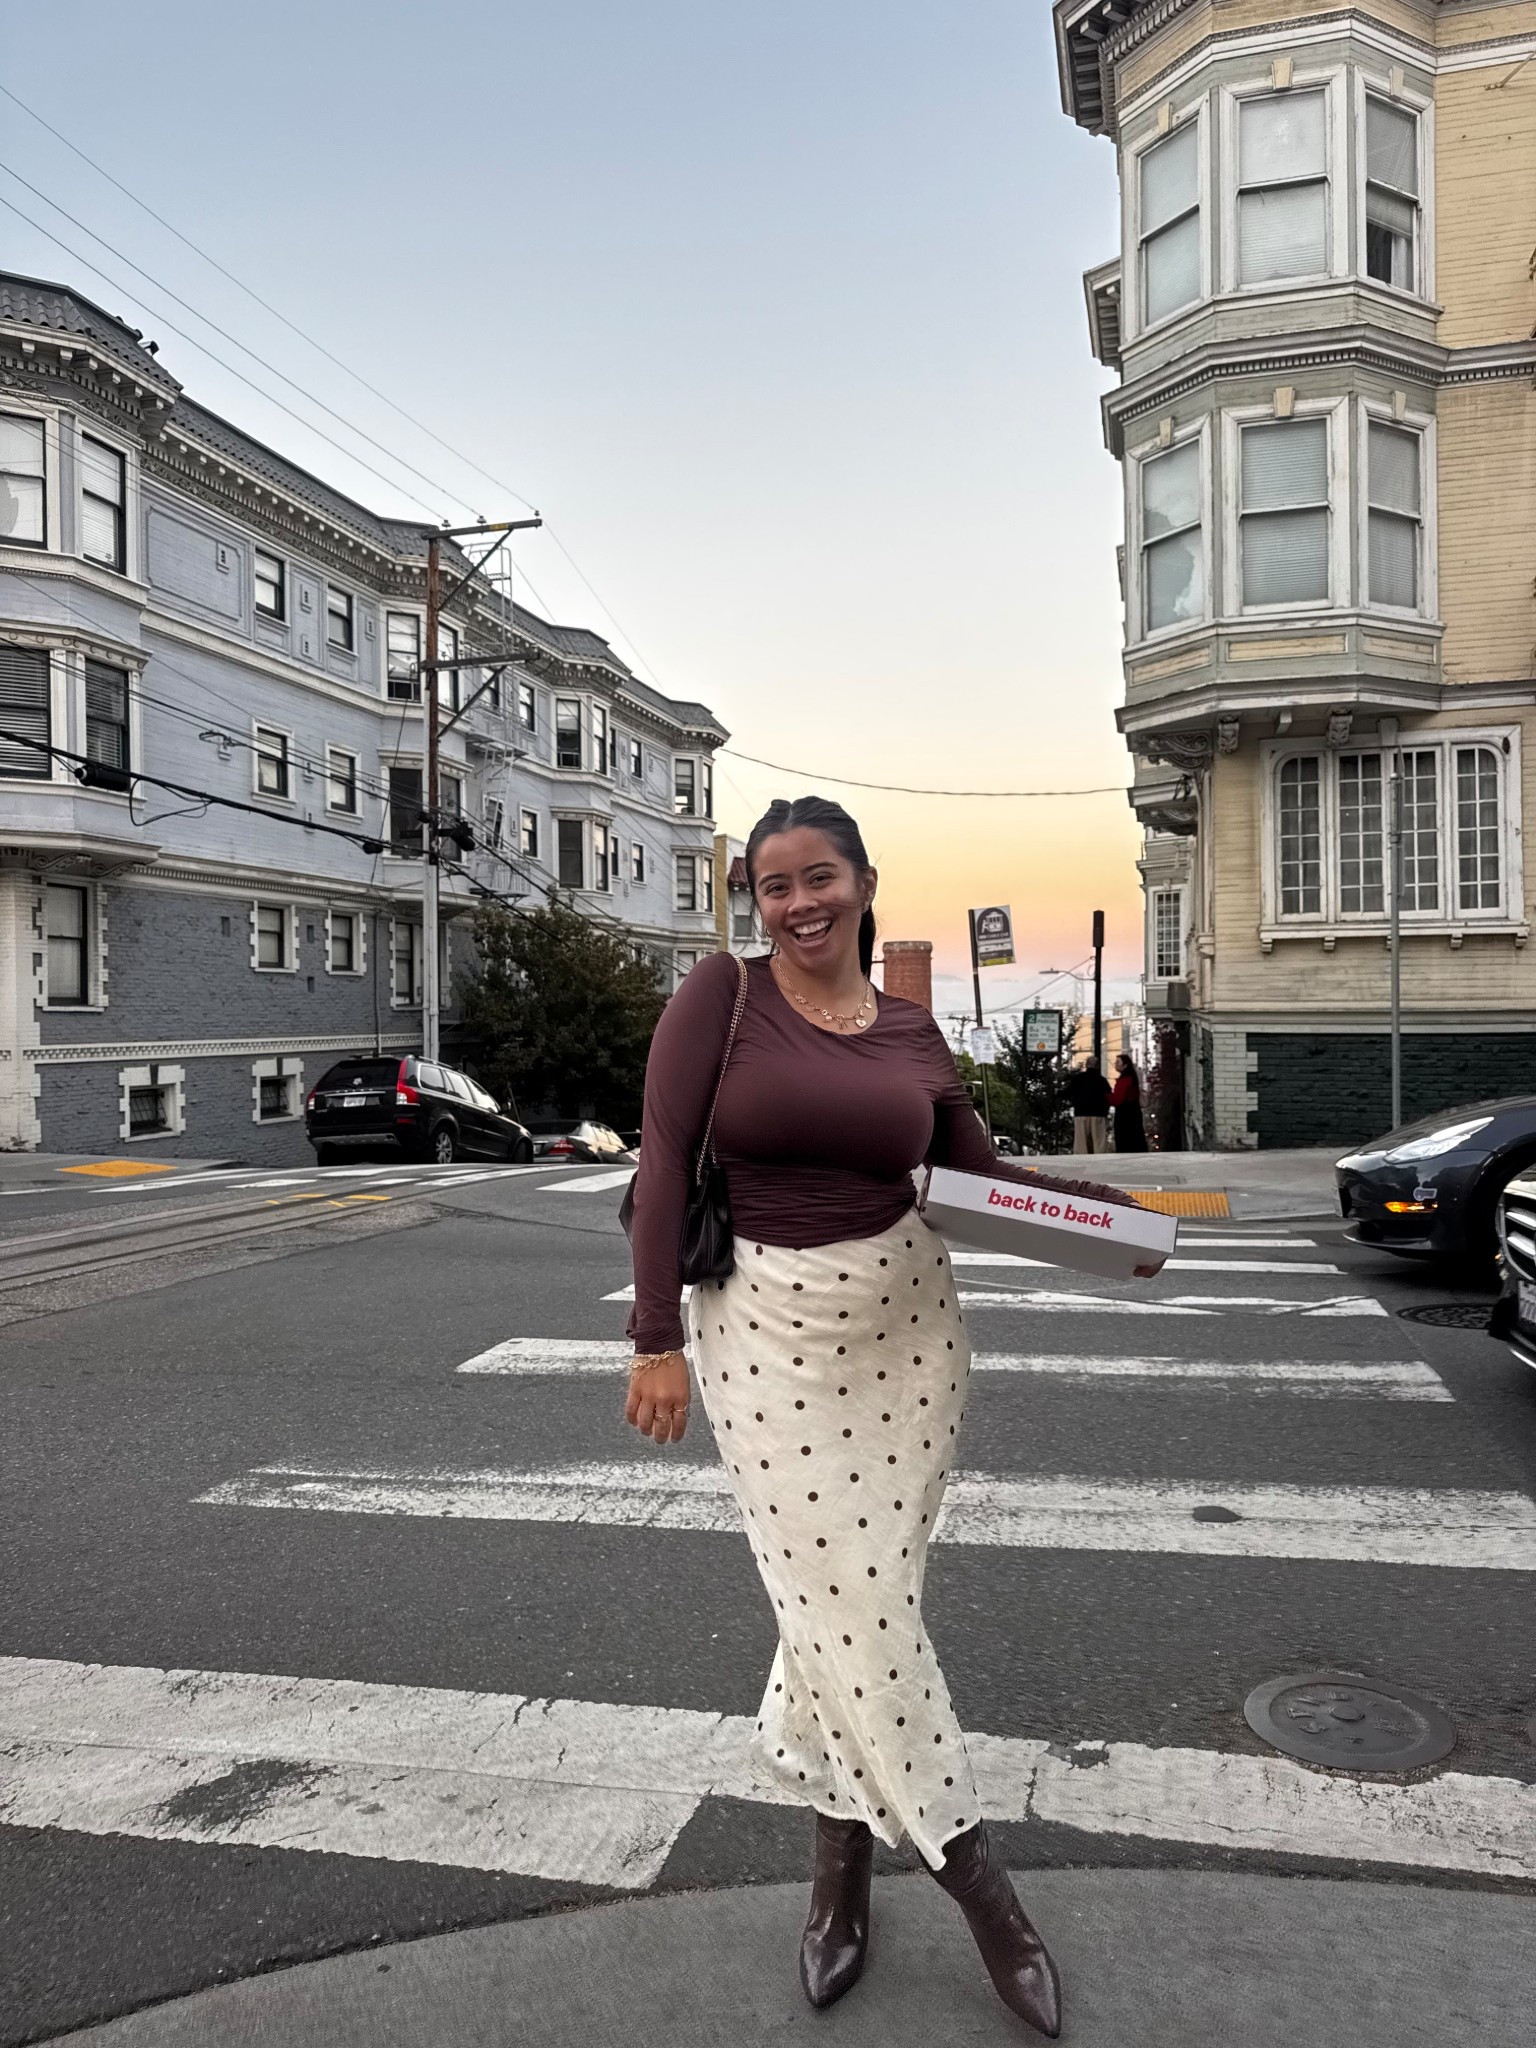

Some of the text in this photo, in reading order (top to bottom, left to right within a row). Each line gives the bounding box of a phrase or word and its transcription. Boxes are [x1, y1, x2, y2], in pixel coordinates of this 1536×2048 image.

[1028, 1014, 1035, 1023] 2
[987, 1188, 1114, 1229] back to back
